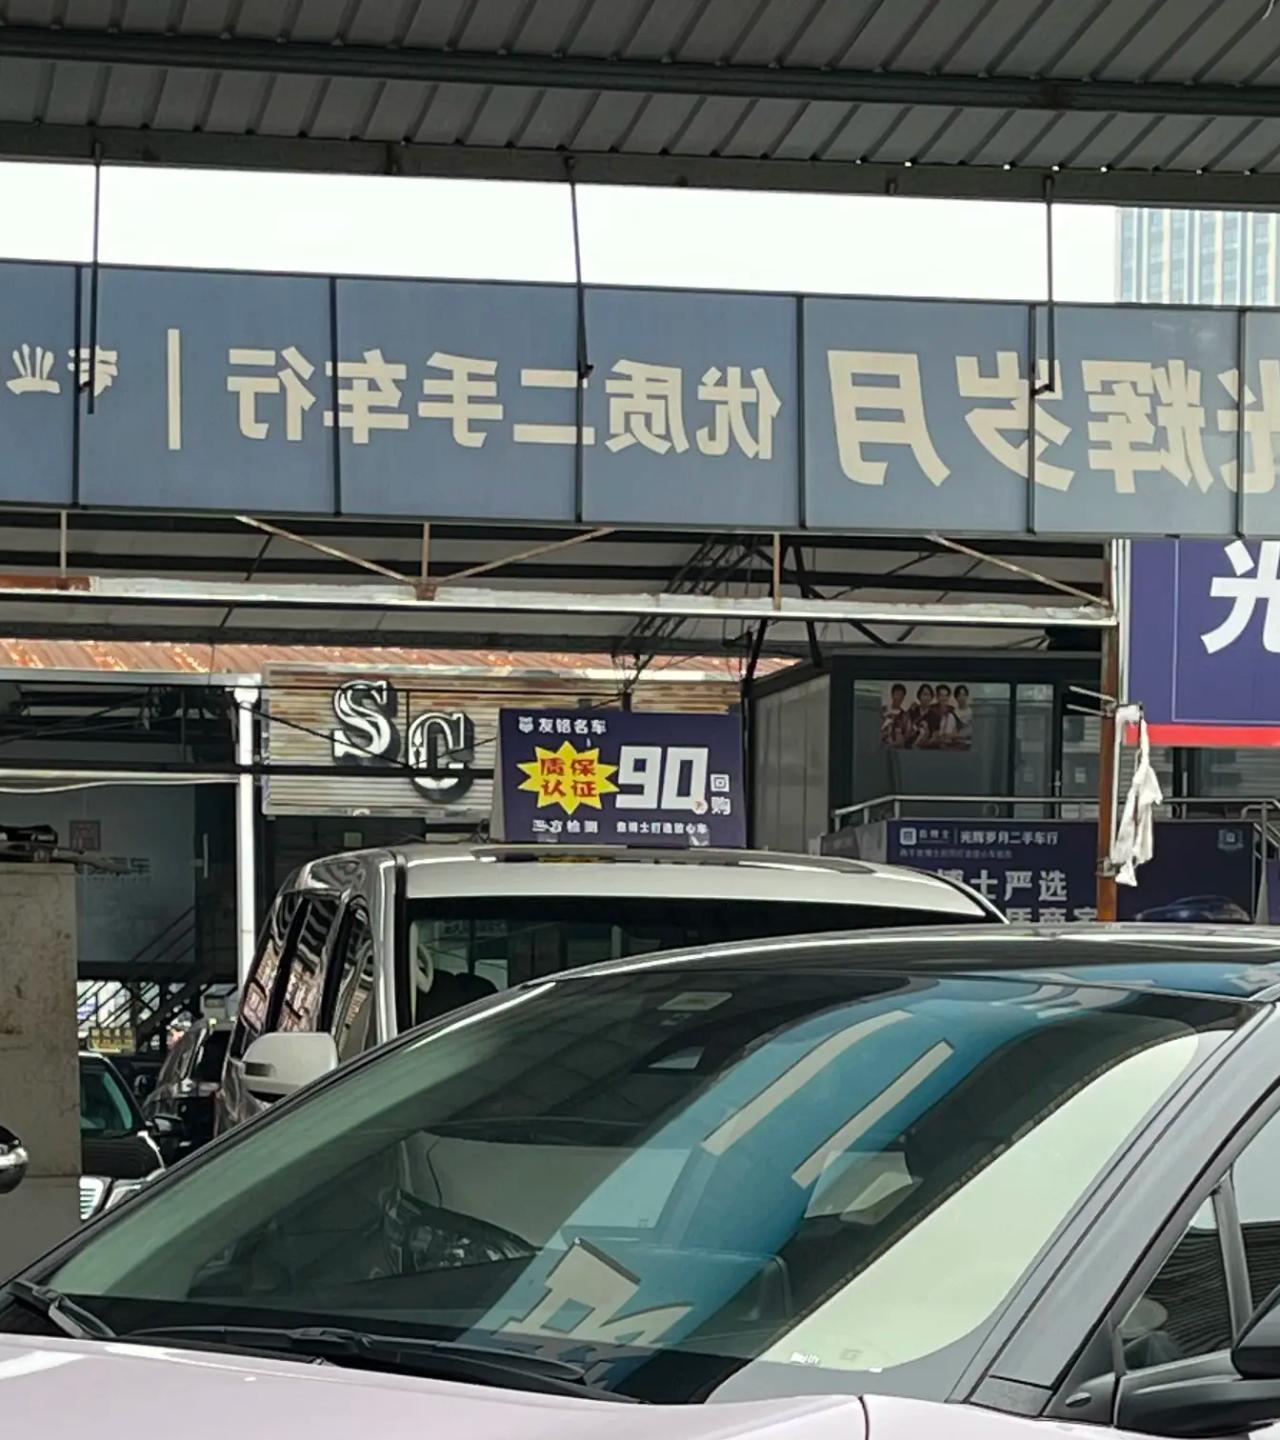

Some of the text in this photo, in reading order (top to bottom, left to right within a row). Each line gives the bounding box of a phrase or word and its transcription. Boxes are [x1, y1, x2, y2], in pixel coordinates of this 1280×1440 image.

[540, 757, 597, 776] 质保
[615, 745, 709, 810] 90
[540, 779, 597, 798] 认证
